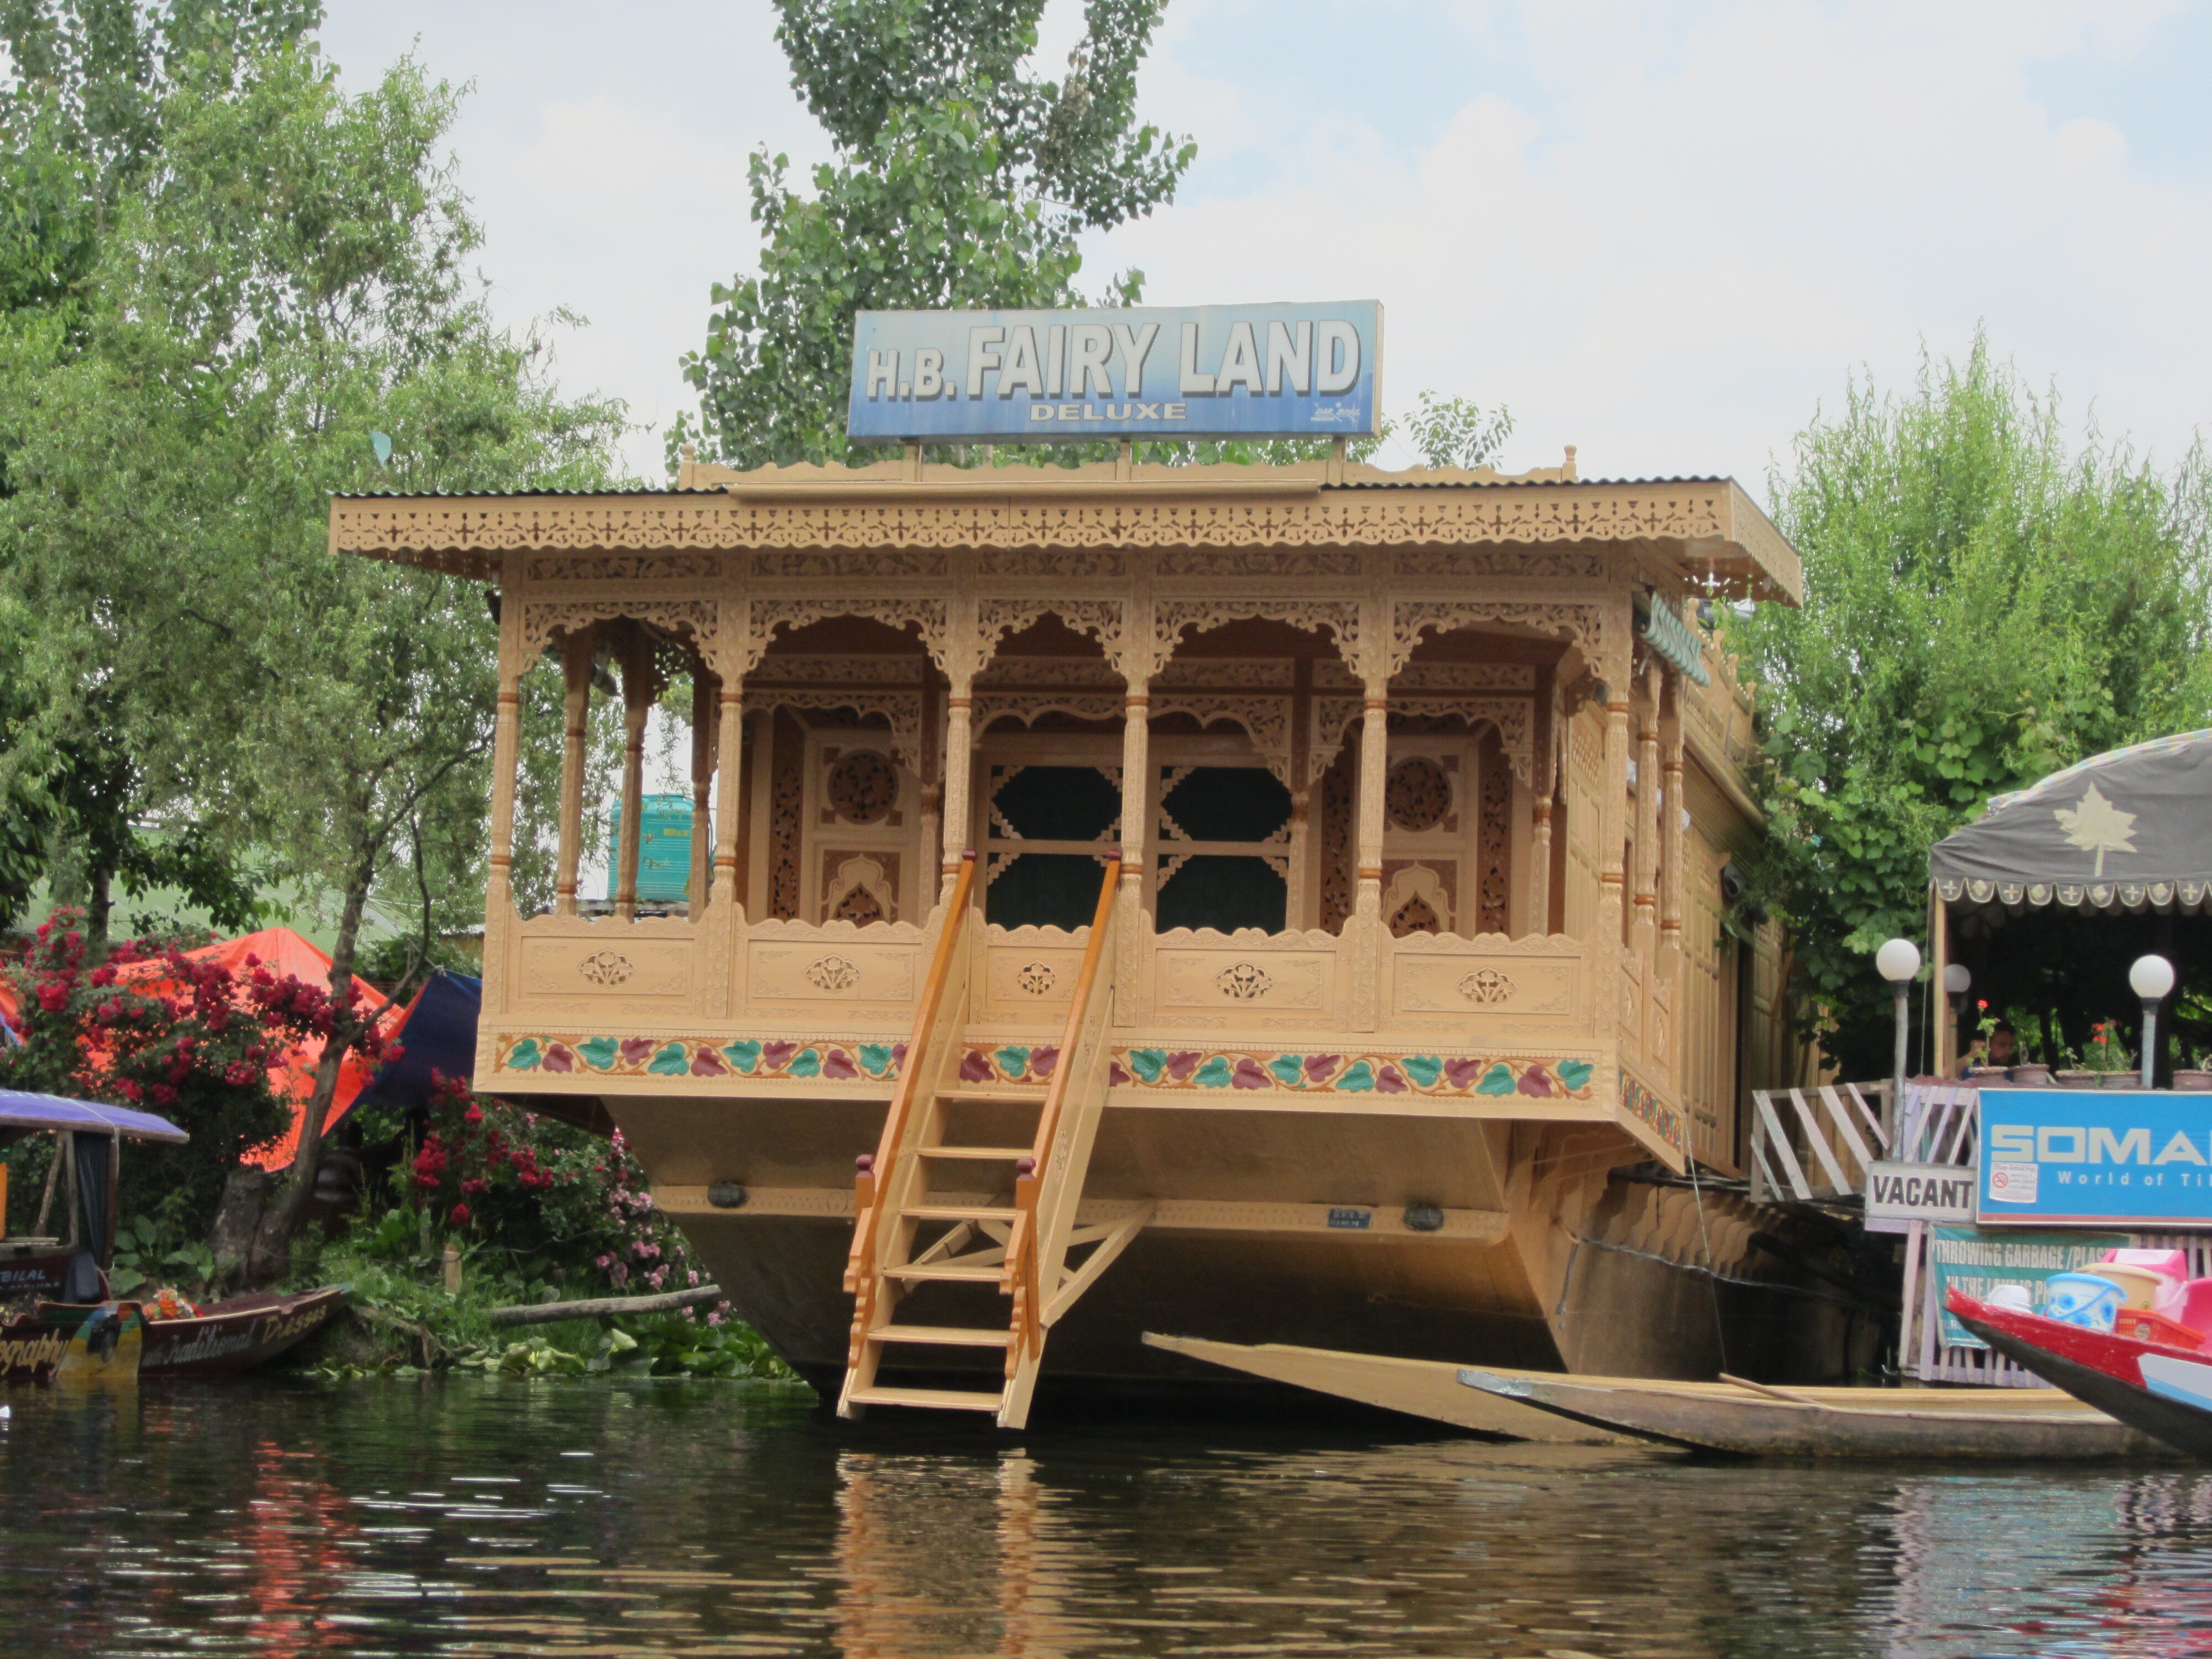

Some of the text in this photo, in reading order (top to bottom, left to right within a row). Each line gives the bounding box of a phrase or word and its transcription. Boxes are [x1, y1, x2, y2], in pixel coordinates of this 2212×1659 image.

[866, 320, 1361, 403] H.B. FAIRY LAND
[1029, 402, 1187, 422] DELUXE
[1991, 1124, 2212, 1166] SOMA
[1872, 1175, 1974, 1209] VACANT
[2057, 1170, 2212, 1187] World of Ti
[1934, 1239, 2109, 1271] THROWING GARBAGE /PLAS
[0, 1327, 70, 1377] ography
[163, 1318, 257, 1365] Traditional
